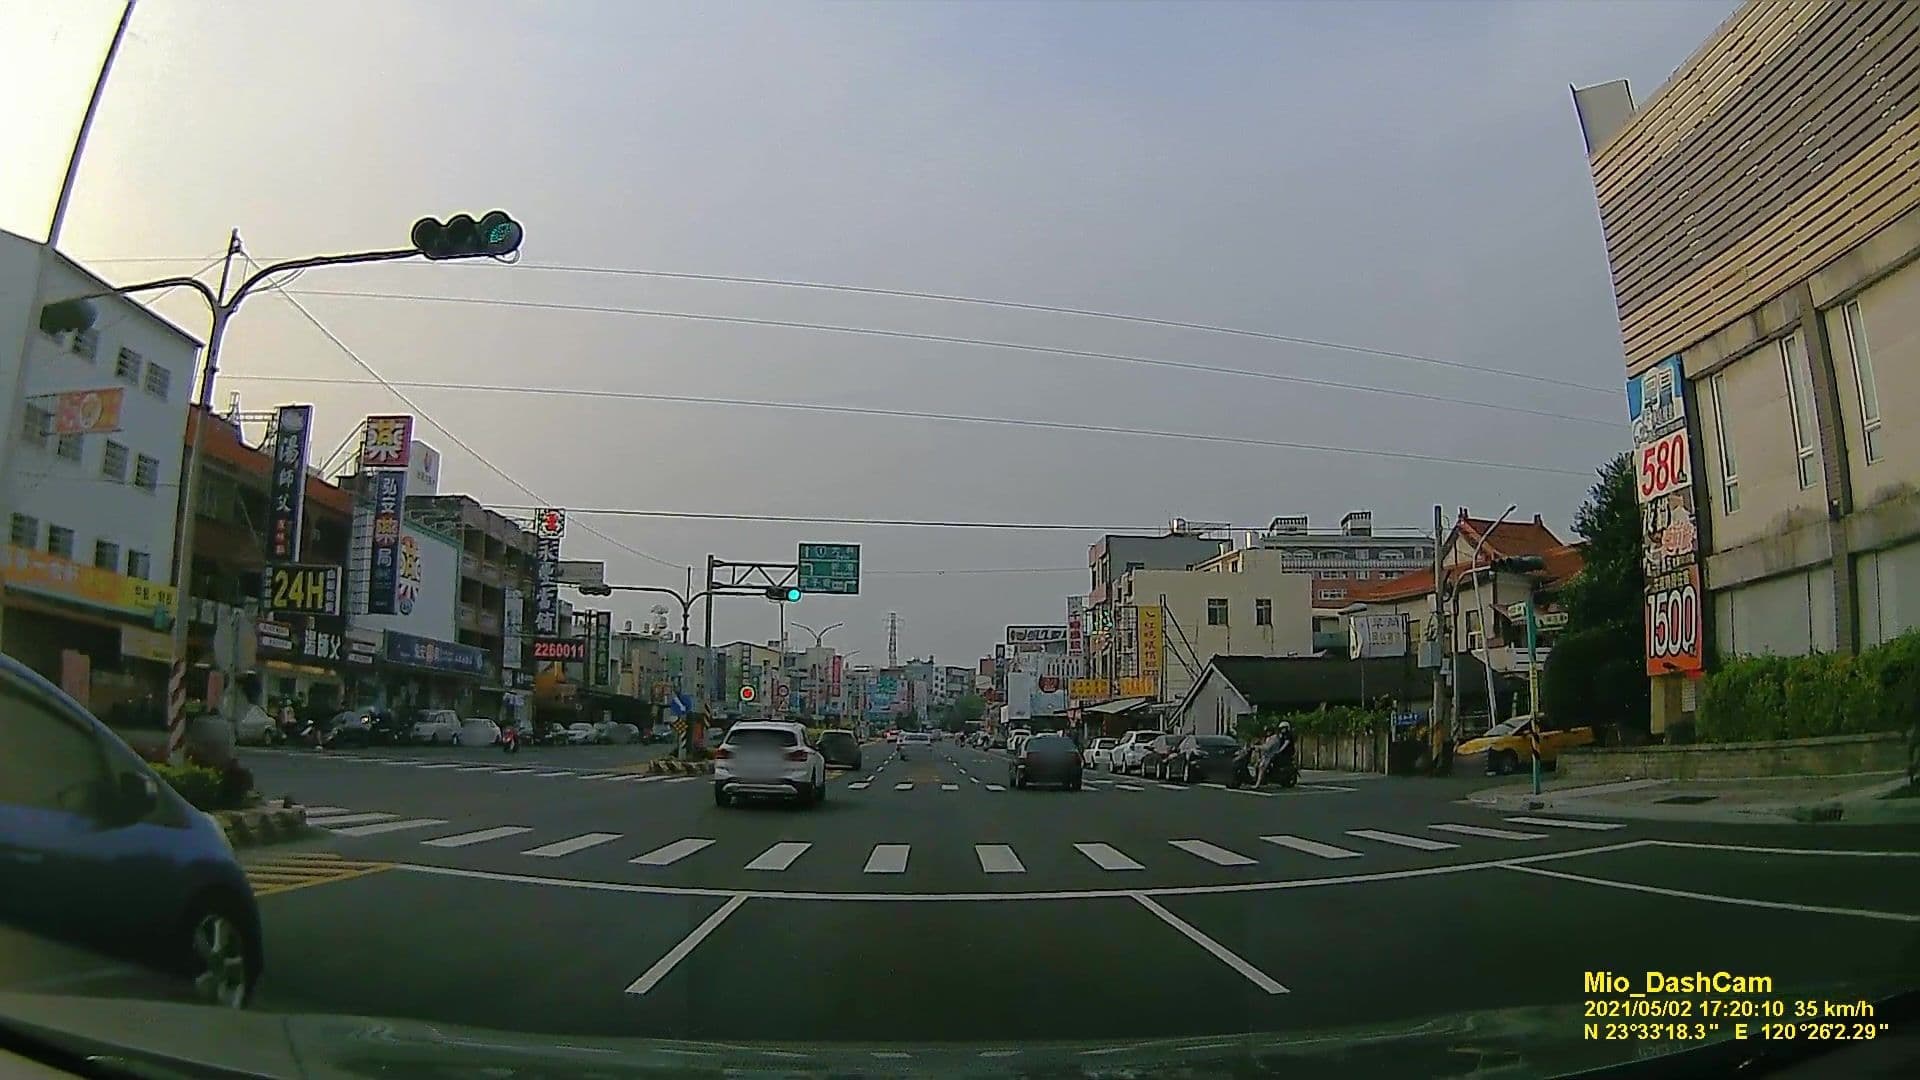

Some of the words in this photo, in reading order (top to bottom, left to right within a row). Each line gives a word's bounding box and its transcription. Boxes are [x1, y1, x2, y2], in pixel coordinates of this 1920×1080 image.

[1641, 434, 1685, 496] 580
[273, 569, 325, 609] 24H
[1647, 585, 1697, 657] 1500
[534, 642, 585, 658] 2260011
